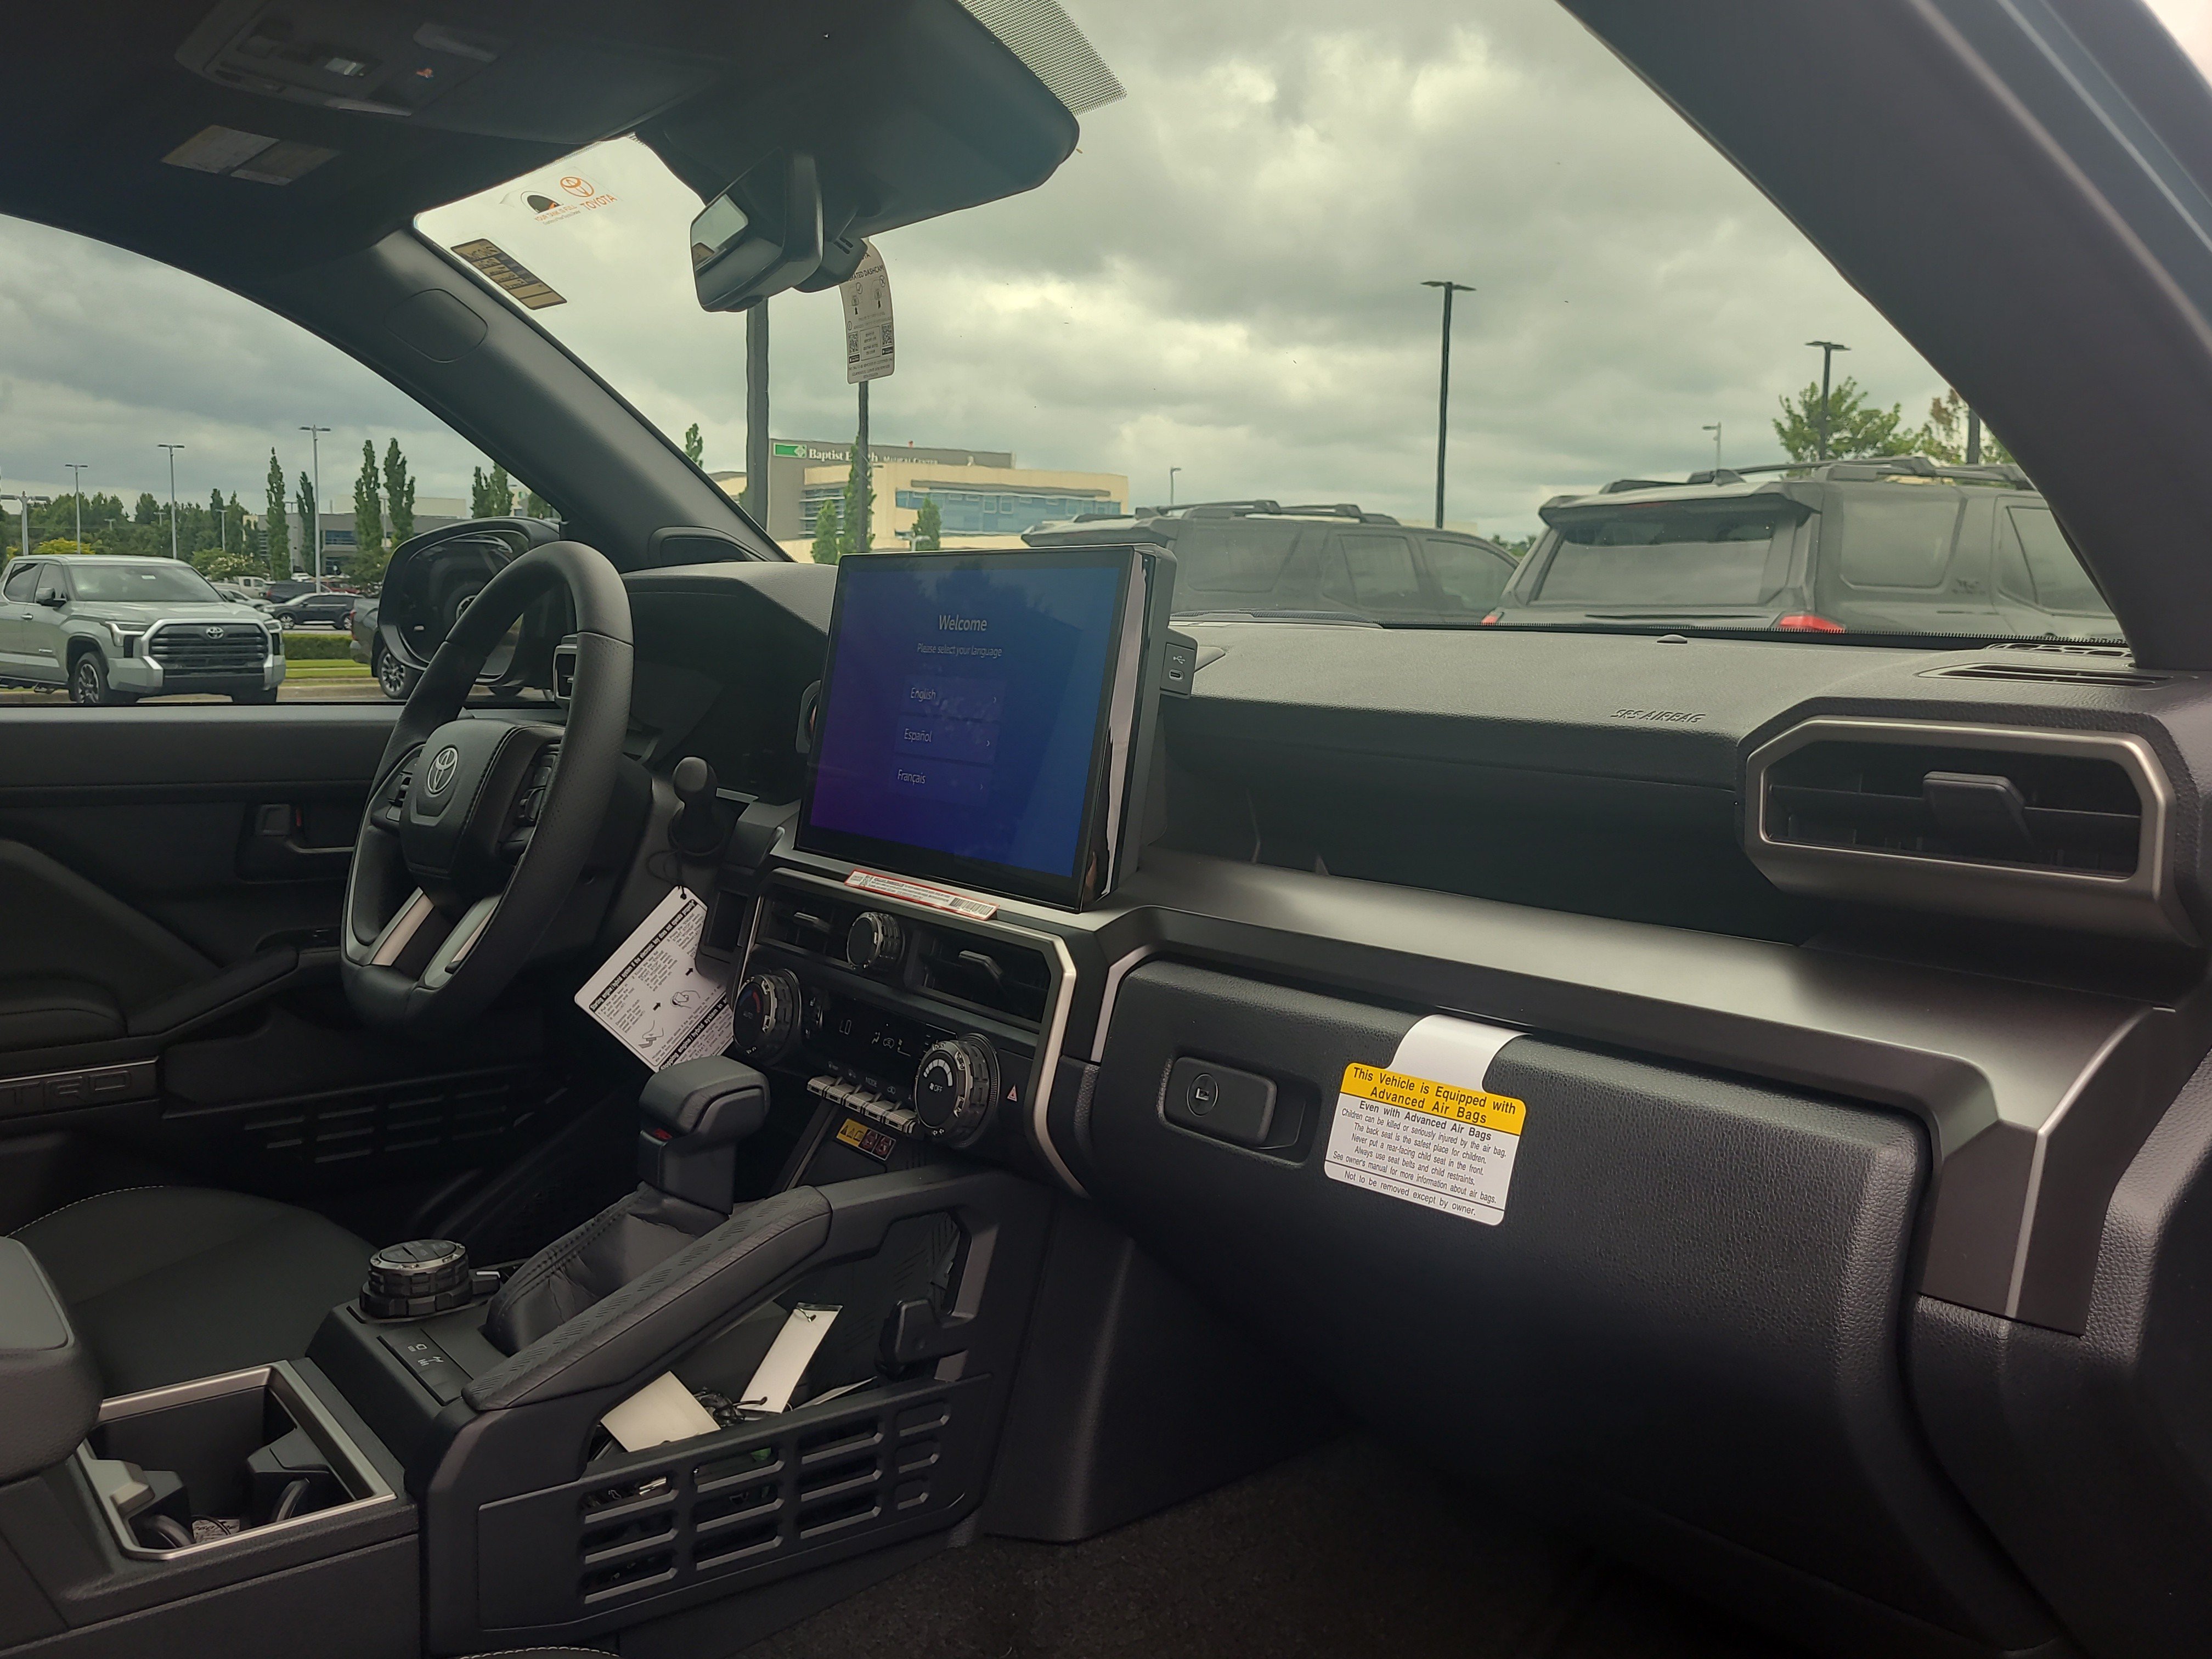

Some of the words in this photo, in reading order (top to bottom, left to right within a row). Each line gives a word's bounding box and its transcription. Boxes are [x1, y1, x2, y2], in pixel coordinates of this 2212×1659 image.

[580, 194, 618, 211] TOYOTA
[809, 449, 844, 462] Baptist
[939, 614, 988, 631] Welcome
[917, 642, 936, 653] Please
[938, 644, 956, 654] select
[956, 646, 970, 656] your
[971, 645, 1003, 659] language
[911, 687, 936, 702] English
[1610, 709, 1644, 719] SRS
[1639, 710, 1706, 723] AIRBAG
[904, 727, 932, 743] Español
[898, 769, 926, 786] Français
[839, 1019, 852, 1035] LO
[934, 1084, 943, 1092] OFF
[1353, 1066, 1373, 1081] This
[1380, 1073, 1414, 1091] Vehicle
[1420, 1082, 1429, 1094] is
[1435, 1086, 1487, 1107] Equipped
[1493, 1101, 1515, 1114] with
[1370, 1086, 1425, 1108] Advanced
[1431, 1101, 1449, 1114] Air
[1456, 1106, 1486, 1123] Bags
[1359, 1100, 1379, 1113] Even
[1384, 1107, 1400, 1118] with
[1404, 1111, 1447, 1129] Advanced
[1450, 1122, 1464, 1133] Air
[1468, 1127, 1491, 1141] Bags
[1341, 1108, 1363, 1120] Children
[1376, 1116, 1384, 1125] be
[1386, 1119, 1401, 1130] killed
[1410, 1127, 1436, 1140] seriously
[1438, 1132, 1458, 1144] injured
[1460, 1137, 1468, 1148] by
[1470, 1140, 1480, 1149] the
[1482, 1144, 1491, 1152] air
[1493, 1146, 1506, 1158] bag.
[1355, 1122, 1364, 1132] The
[1365, 1125, 1379, 1136] back
[1381, 1131, 1392, 1139] seat
[1402, 1135, 1411, 1144] the
[1413, 1139, 1431, 1149] safest
[1432, 1143, 1448, 1154] place
[1451, 1147, 1460, 1156] for
[1462, 1150, 1486, 1164] children.
[1351, 1132, 1367, 1143] Never
[1386, 1144, 1415, 1159] rear-facing
[1418, 1151, 1431, 1161] child
[1433, 1156, 1446, 1165] seat
[1448, 1158, 1454, 1167] in
[1457, 1161, 1466, 1170] the
[1469, 1164, 1483, 1175] front.
[1354, 1146, 1373, 1158] Always
[1375, 1152, 1385, 1160] use
[1387, 1156, 1400, 1164] seat
[1402, 1158, 1415, 1169] belts
[1417, 1164, 1429, 1172] and
[1431, 1166, 1445, 1176] child
[1447, 1172, 1475, 1186] restraints.
[1333, 1150, 1343, 1160] See
[1346, 1156, 1365, 1166] owner's
[1368, 1162, 1387, 1172] manual
[1400, 1171, 1413, 1180] more
[1416, 1173, 1447, 1189] information
[1449, 1184, 1466, 1195] about
[1469, 1189, 1477, 1198] air
[1480, 1191, 1496, 1204] bags.
[1344, 1170, 1357, 1181] Not
[1359, 1175, 1365, 1183] to
[1368, 1176, 1378, 1187] be
[1380, 1181, 1409, 1196] removed
[1413, 1190, 1436, 1204] except
[1439, 1198, 1448, 1209] by
[1452, 1202, 1476, 1216] owner.
